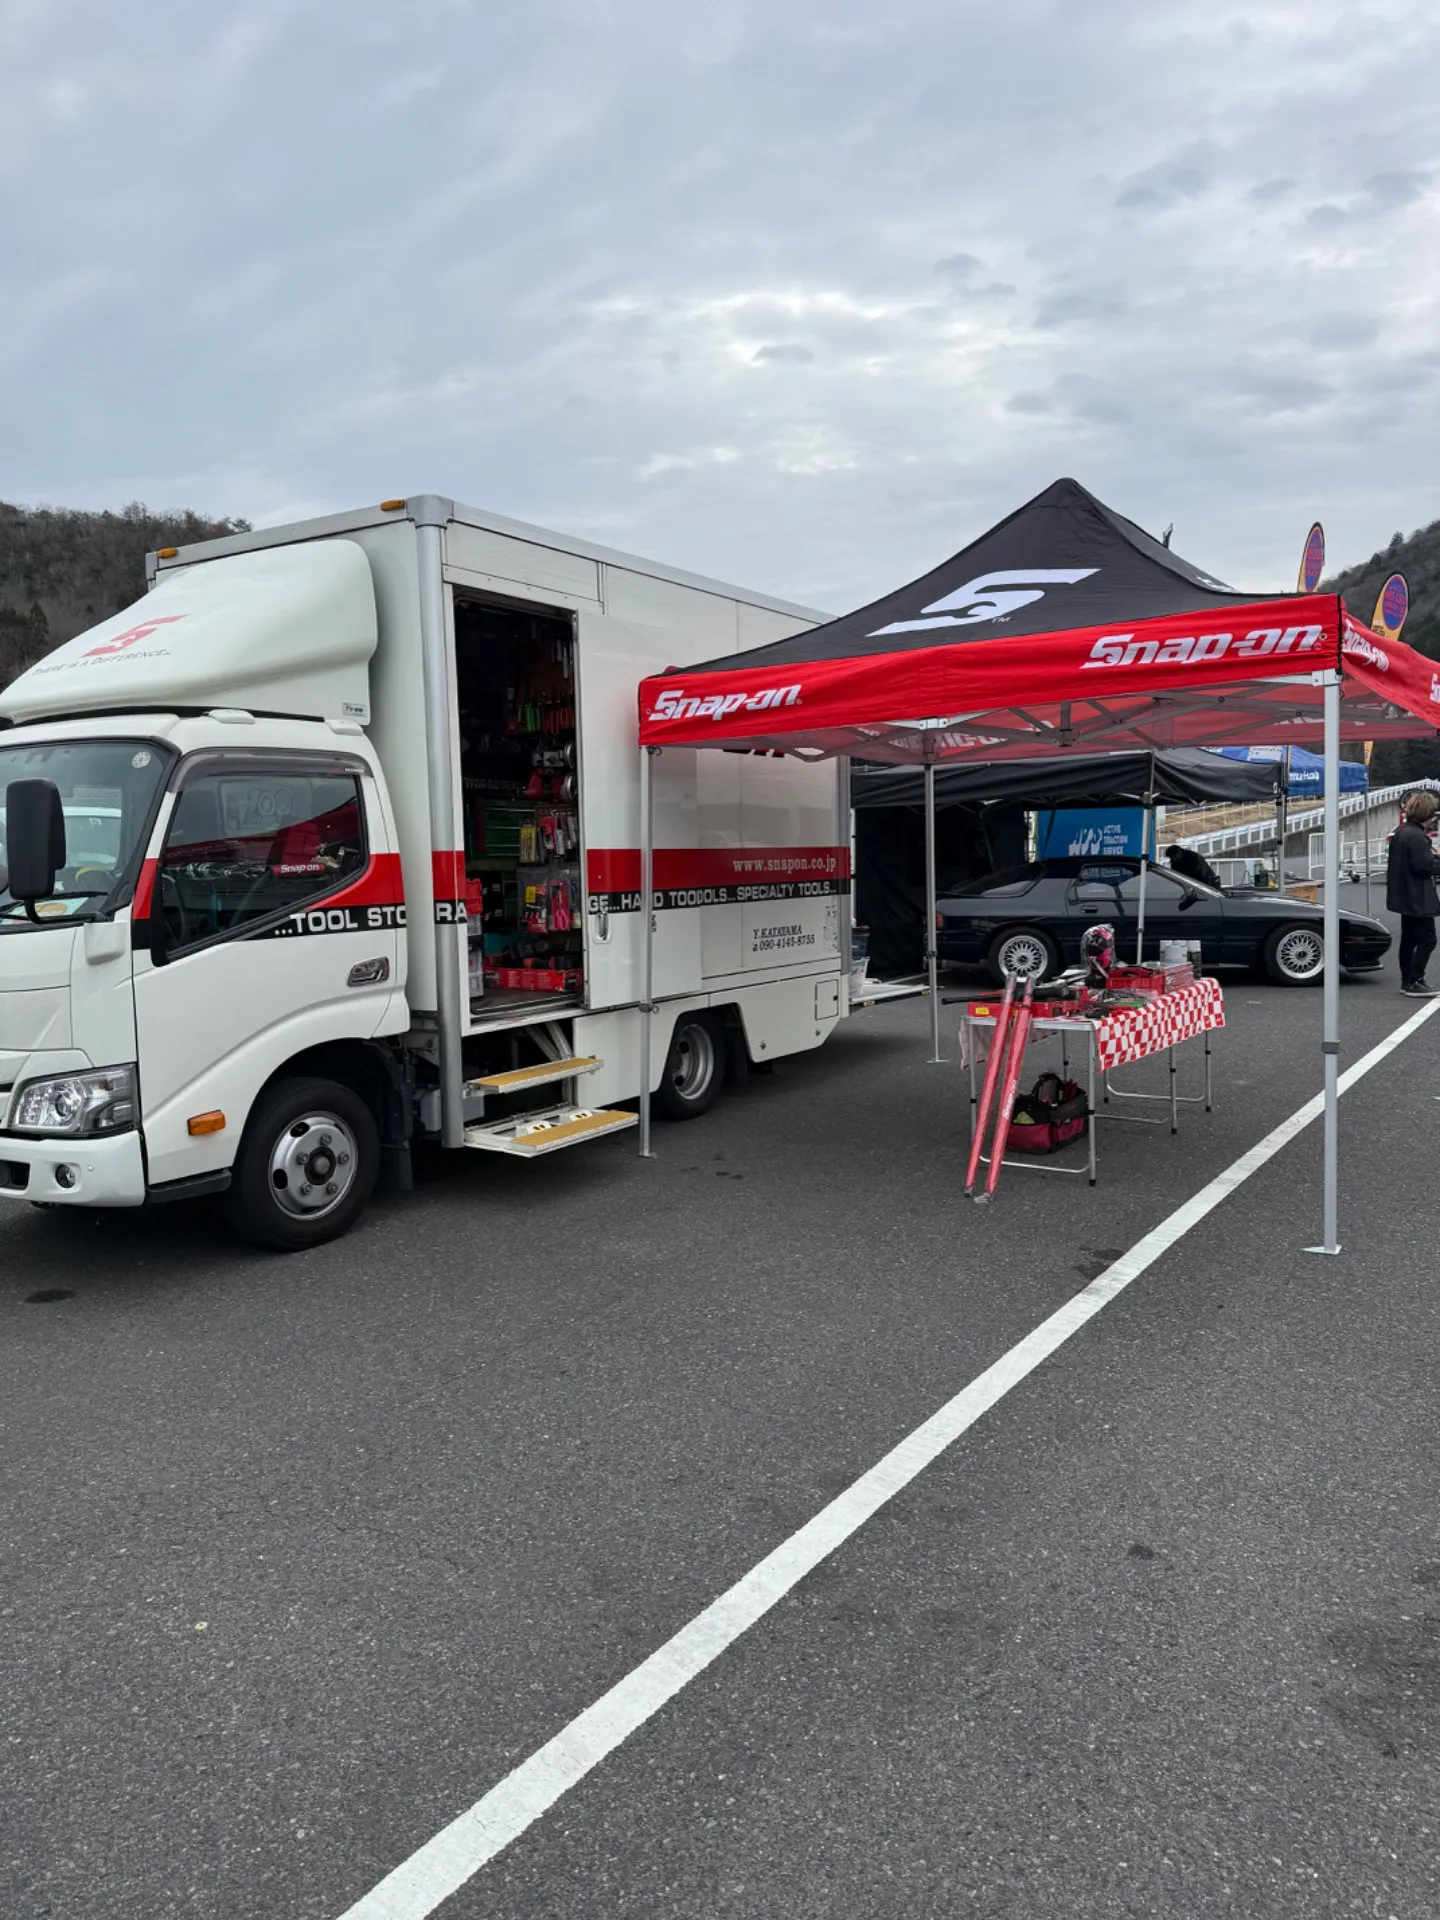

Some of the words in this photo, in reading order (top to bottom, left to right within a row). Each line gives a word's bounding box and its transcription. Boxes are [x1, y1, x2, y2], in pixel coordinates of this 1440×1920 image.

[1080, 625, 1322, 669] Snap-on
[648, 684, 802, 721] Snap-on
[732, 854, 837, 874] www.snapon.co.jp
